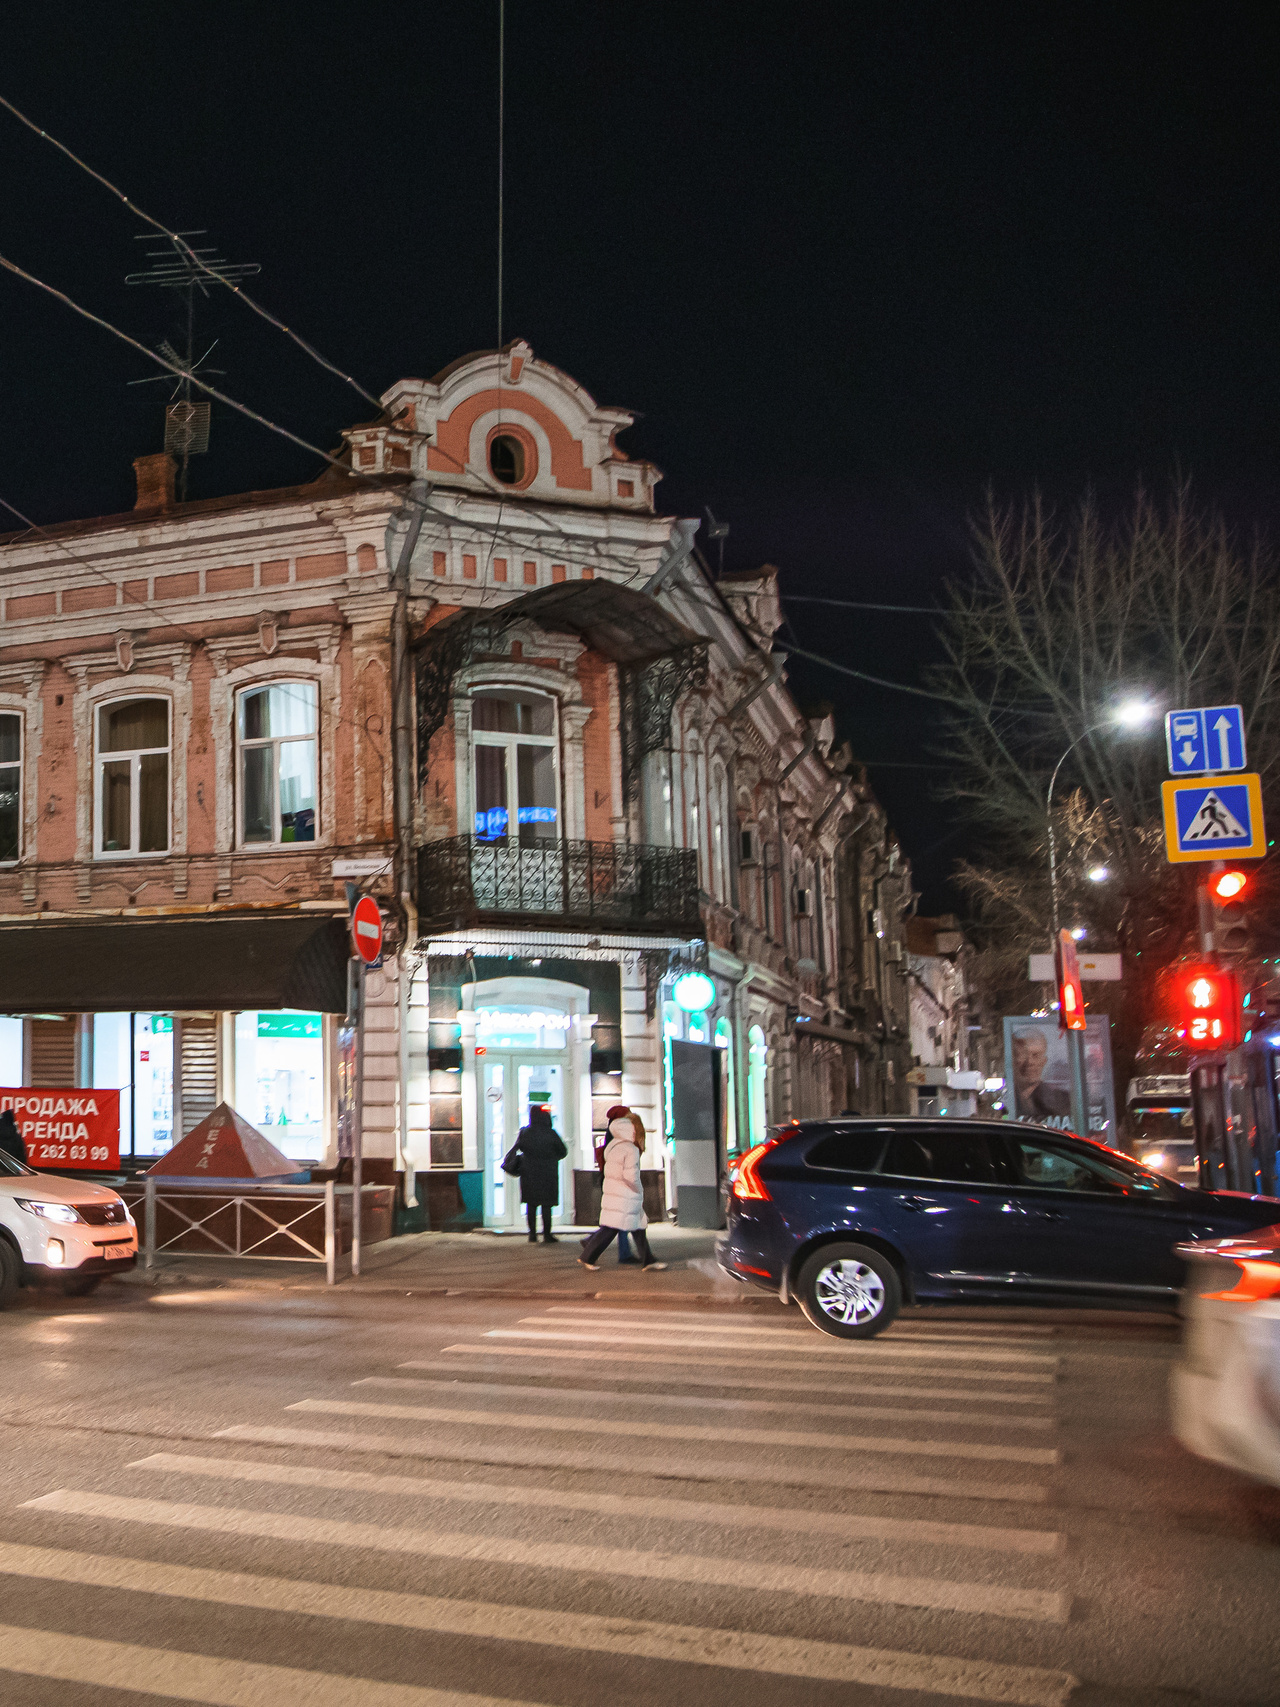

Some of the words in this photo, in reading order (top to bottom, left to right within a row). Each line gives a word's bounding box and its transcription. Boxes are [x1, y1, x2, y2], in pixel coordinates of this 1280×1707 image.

[1191, 1018, 1221, 1039] 21
[0, 1096, 99, 1118] ПРОДАЖА
[13, 1121, 89, 1142] РЕНДА
[40, 1144, 68, 1159] 262
[70, 1145, 88, 1161] 63
[90, 1146, 110, 1161] 99
